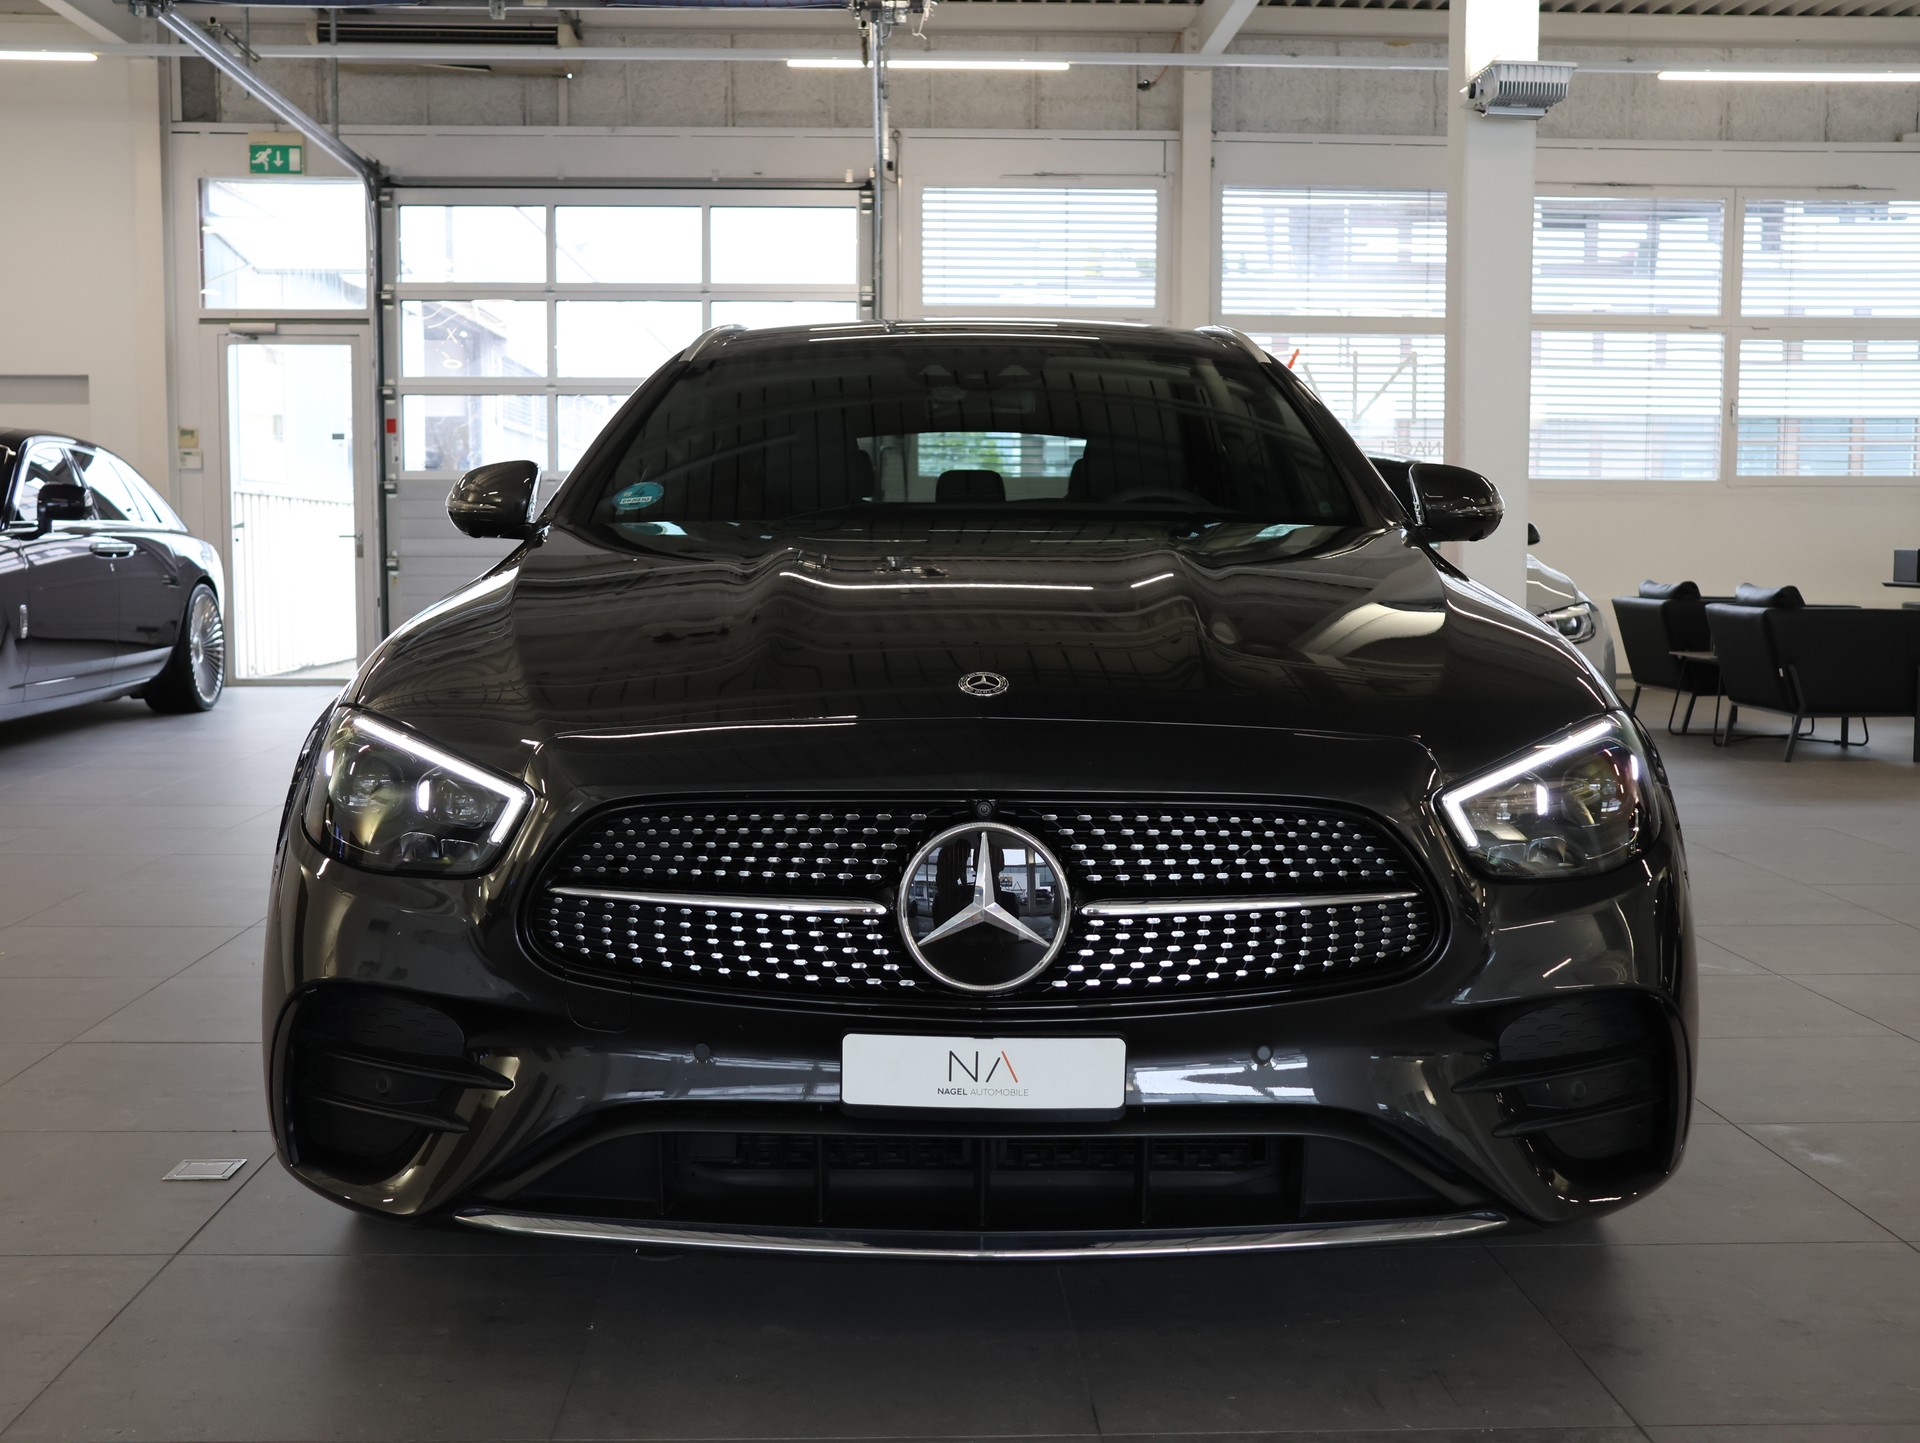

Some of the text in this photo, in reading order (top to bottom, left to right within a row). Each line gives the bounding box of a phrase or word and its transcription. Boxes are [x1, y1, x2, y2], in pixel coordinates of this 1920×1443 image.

[948, 1049, 1019, 1083] NA
[937, 1087, 1030, 1097] NAGEL AUTOMOBILE
